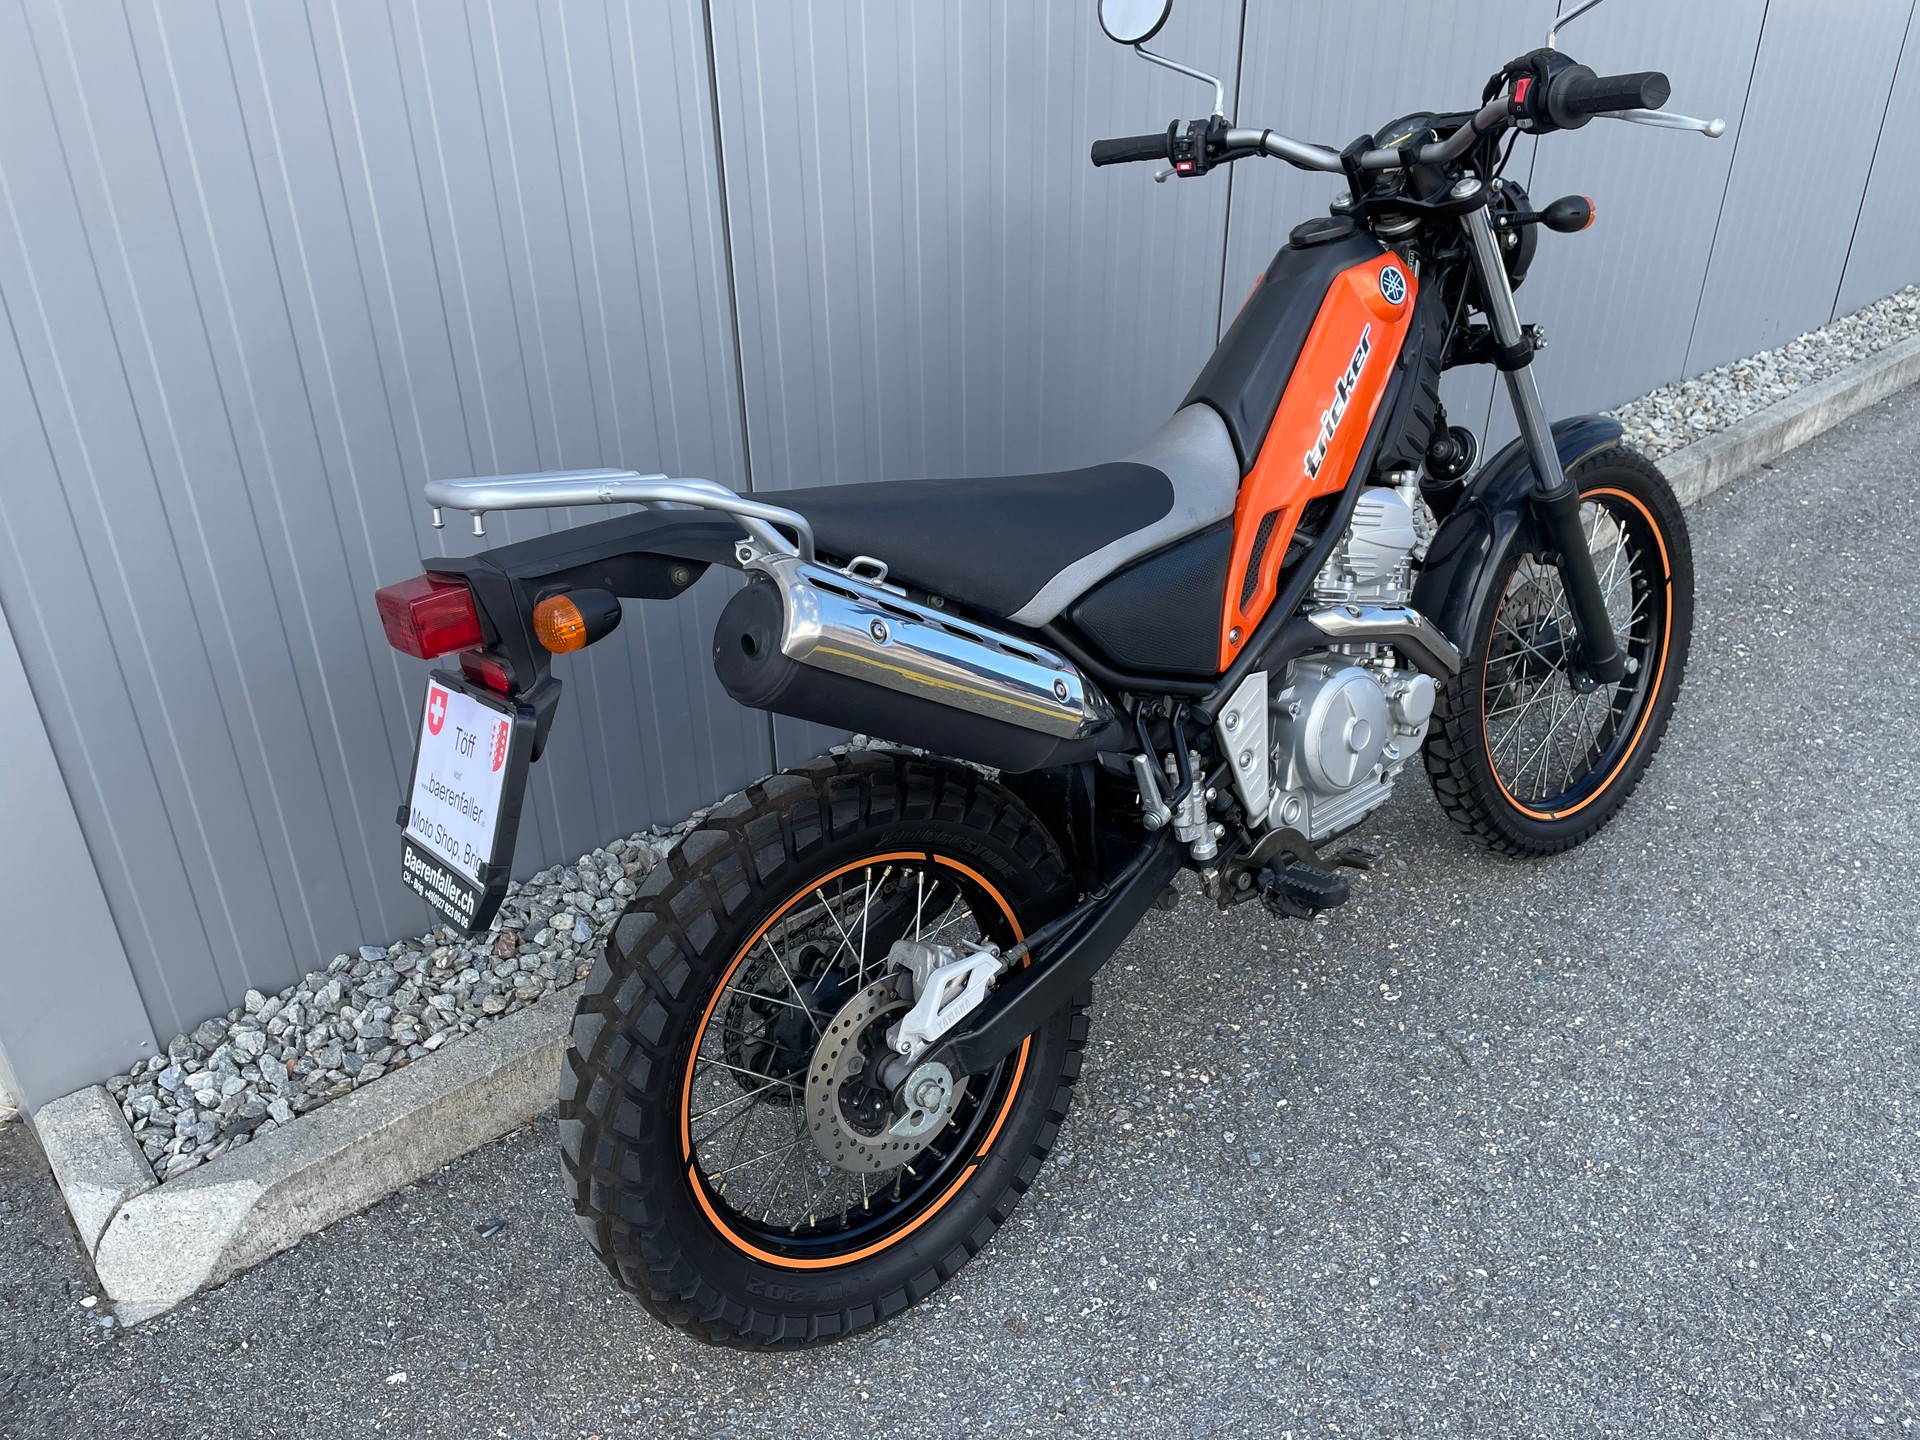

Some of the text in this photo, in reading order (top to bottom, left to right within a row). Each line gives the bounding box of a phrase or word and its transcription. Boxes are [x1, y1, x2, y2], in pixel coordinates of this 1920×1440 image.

[1303, 322, 1371, 480] tricker
[455, 726, 477, 759] Töff
[410, 807, 434, 838] Moto
[434, 823, 461, 862] Shop,
[874, 829, 1019, 880] BRIDGESTONE
[403, 845, 475, 916] Baerenfaller.ch
[413, 877, 424, 896] Brig
[444, 902, 455, 918] 923
[936, 997, 972, 1032] YAMAHA
